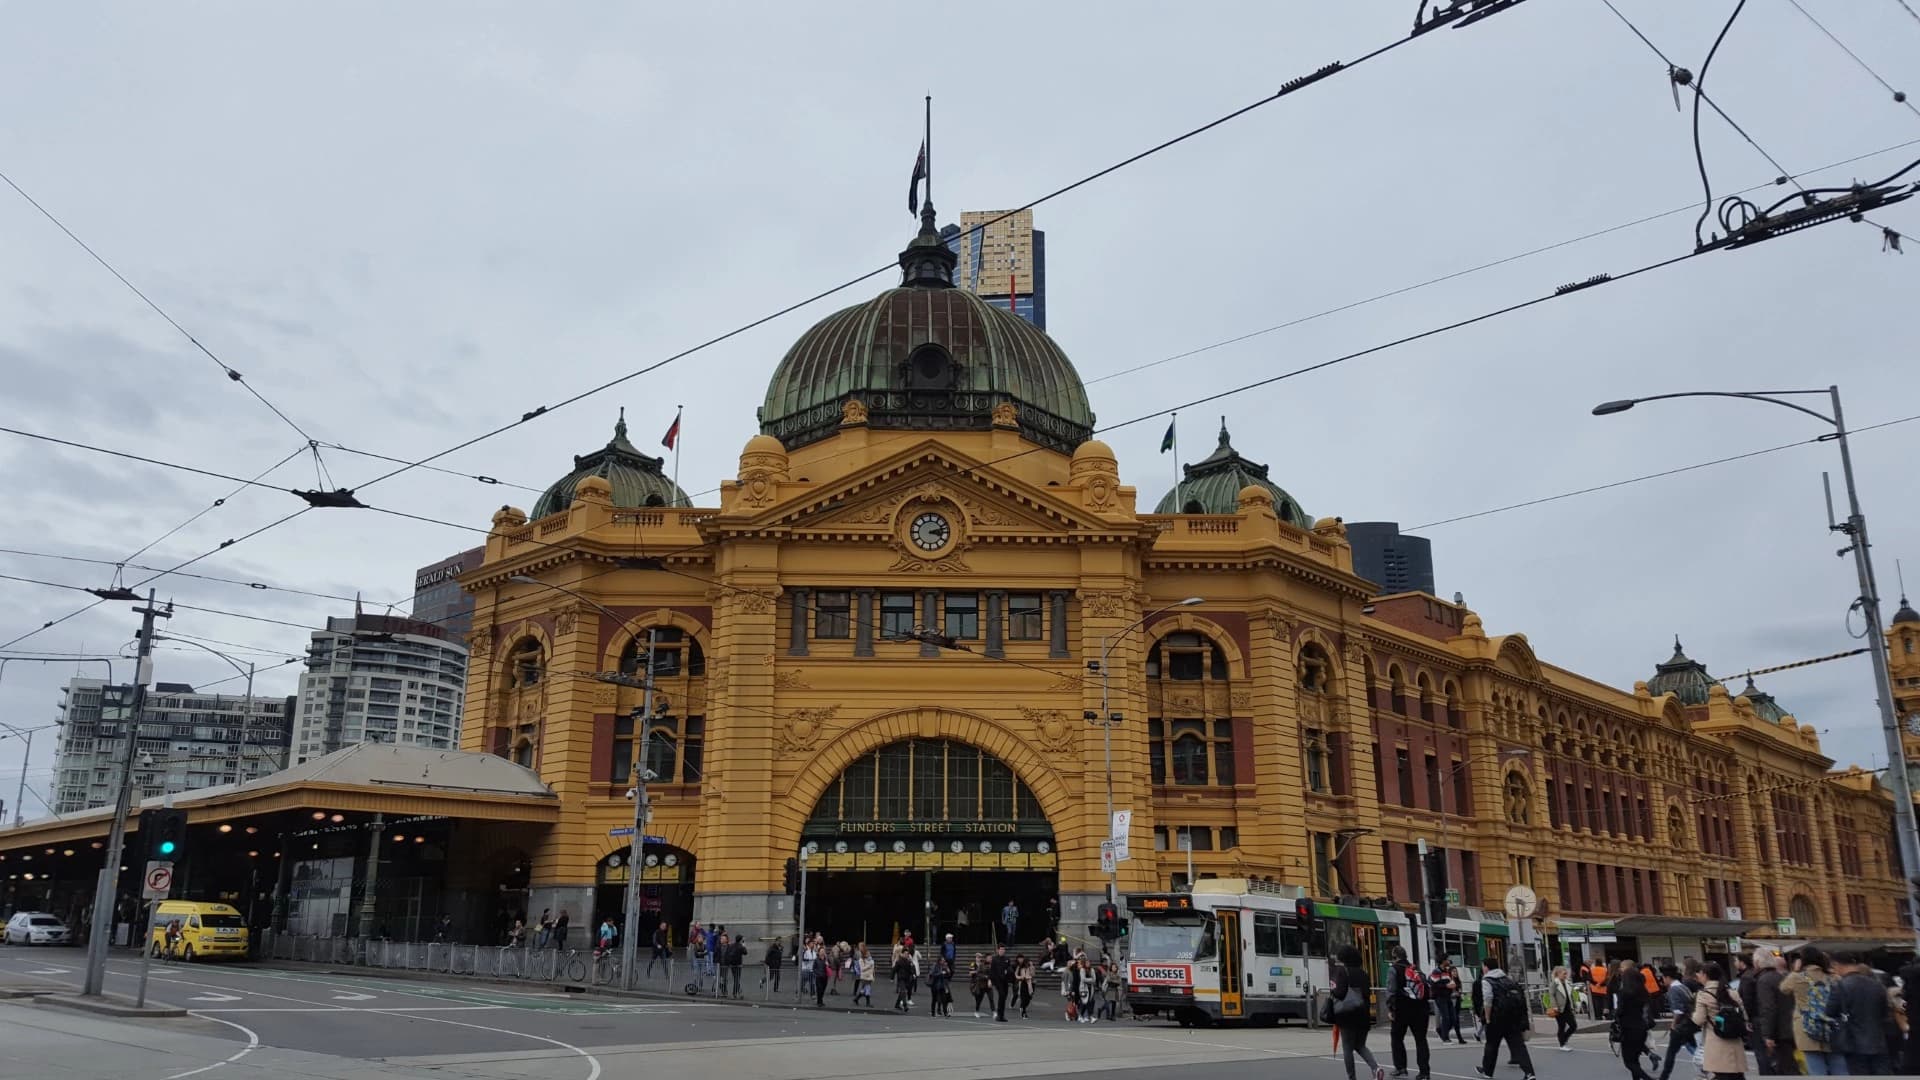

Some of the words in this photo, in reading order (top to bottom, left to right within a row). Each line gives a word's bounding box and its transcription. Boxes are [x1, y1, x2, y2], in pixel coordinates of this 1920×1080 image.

[840, 822, 896, 833] FLINDERS
[910, 822, 951, 833] STREET
[965, 822, 1016, 833] STATION
[1137, 968, 1185, 979] SCORSESE
